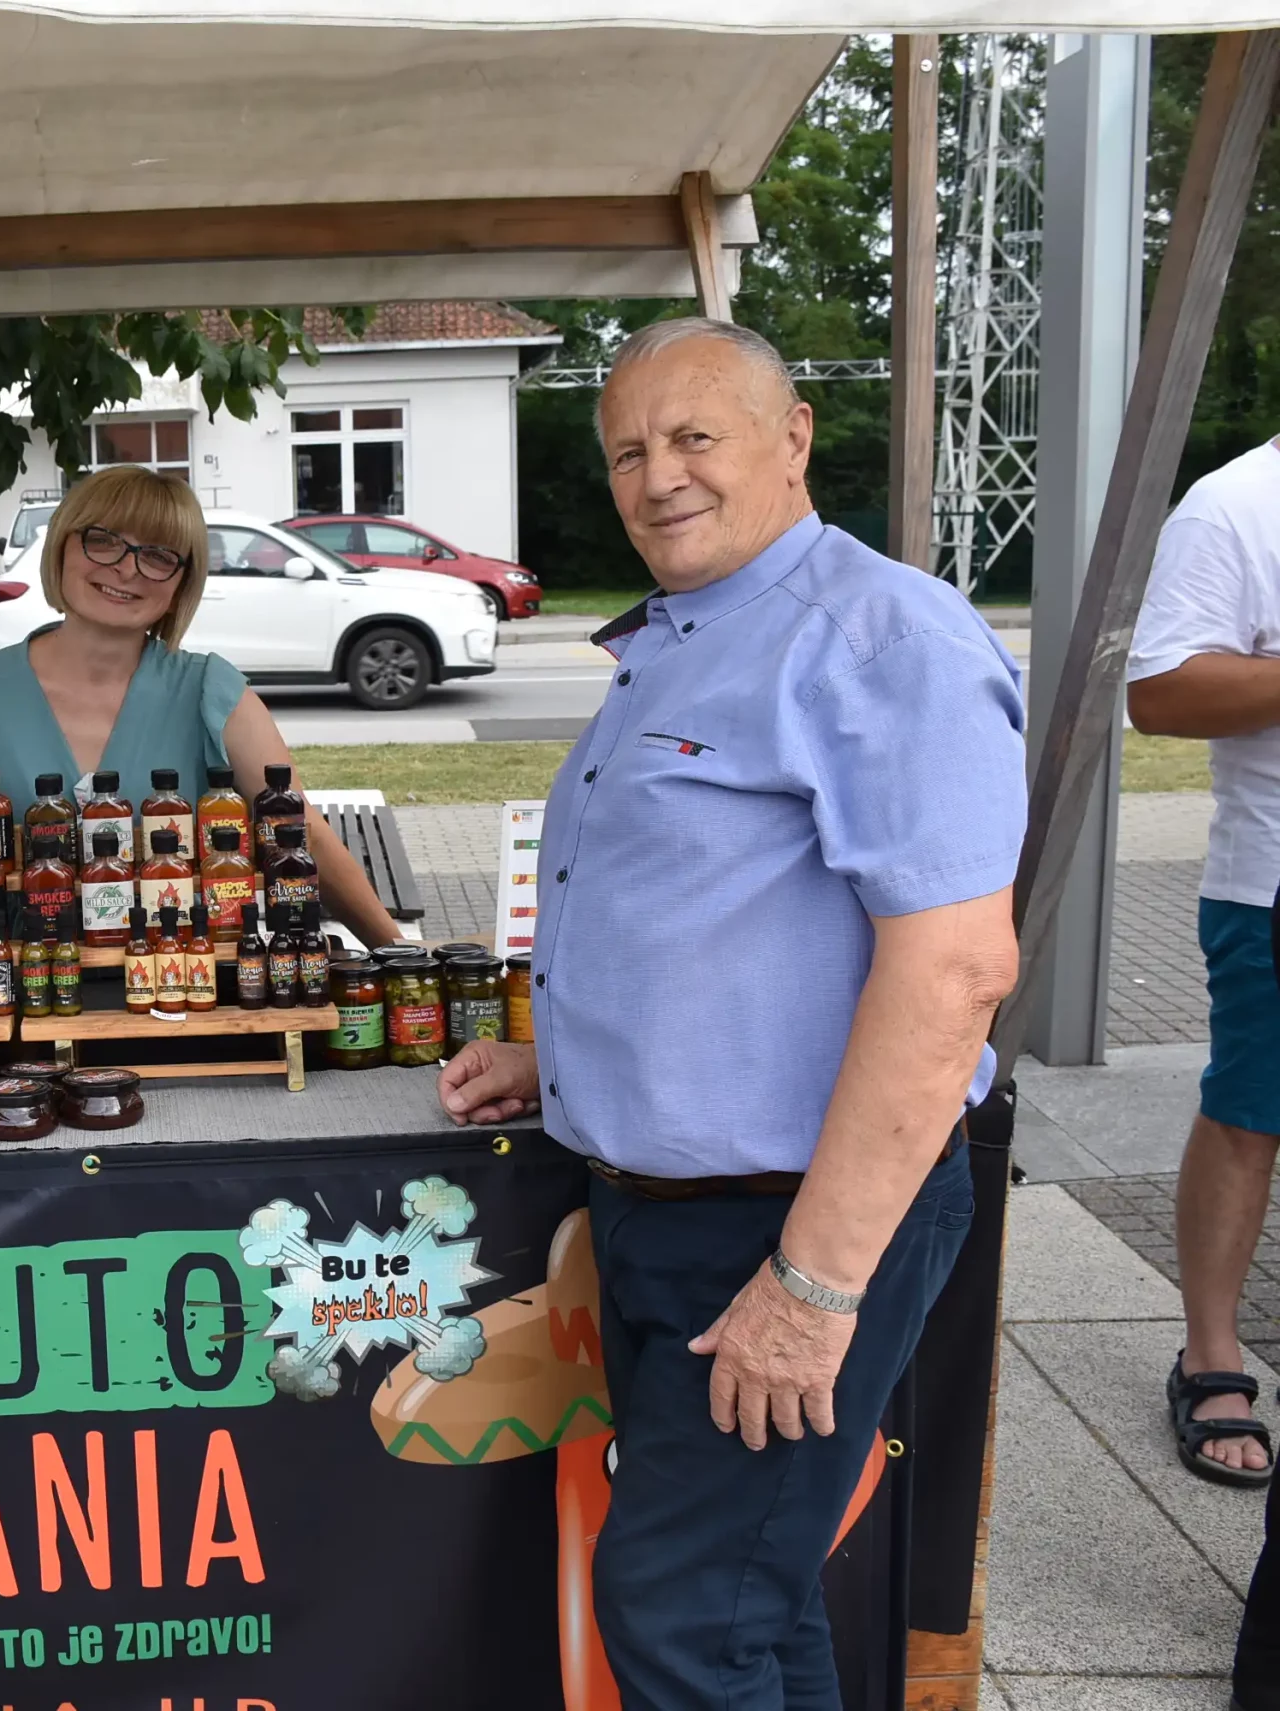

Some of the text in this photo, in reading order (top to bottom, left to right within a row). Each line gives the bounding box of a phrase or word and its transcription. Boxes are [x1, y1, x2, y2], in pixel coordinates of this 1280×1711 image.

[31, 823, 69, 836] SMOKED
[269, 881, 315, 897] Aronia
[28, 891, 73, 905] SMOKED
[85, 896, 132, 907] MILD SAUCE
[23, 975, 49, 987] GREEN
[53, 974, 79, 986] GREEN
[322, 1253, 410, 1282] Bu te
[312, 1279, 428, 1336] speklo!
[57, 1625, 103, 1666] je
